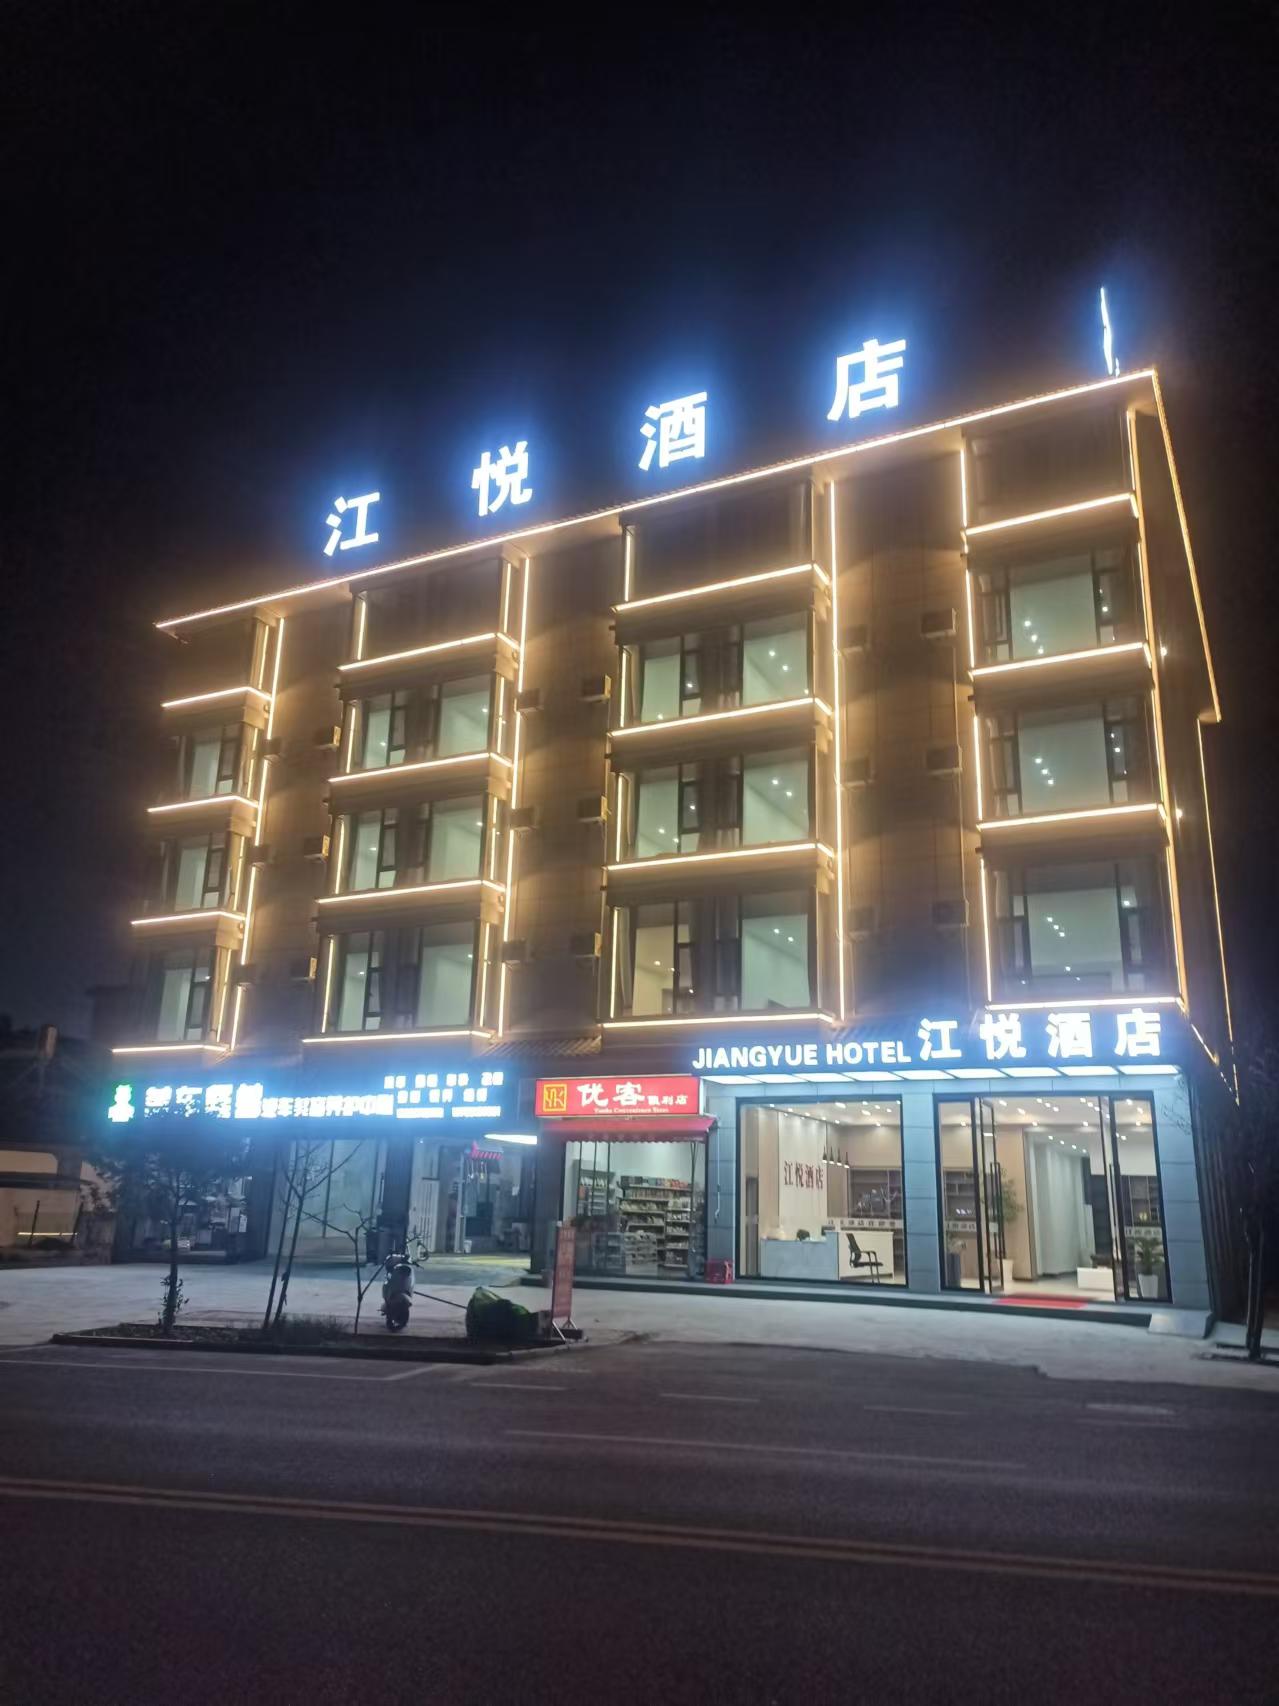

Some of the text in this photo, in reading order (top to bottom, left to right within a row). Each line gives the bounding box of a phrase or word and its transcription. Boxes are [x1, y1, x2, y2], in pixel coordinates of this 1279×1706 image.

[324, 338, 908, 557] 江悦酒店
[692, 1039, 912, 1070] JIANGYUE HOTEL
[918, 1008, 1162, 1062] 江悦酒店
[784, 1160, 824, 1190] 江悦酒店
